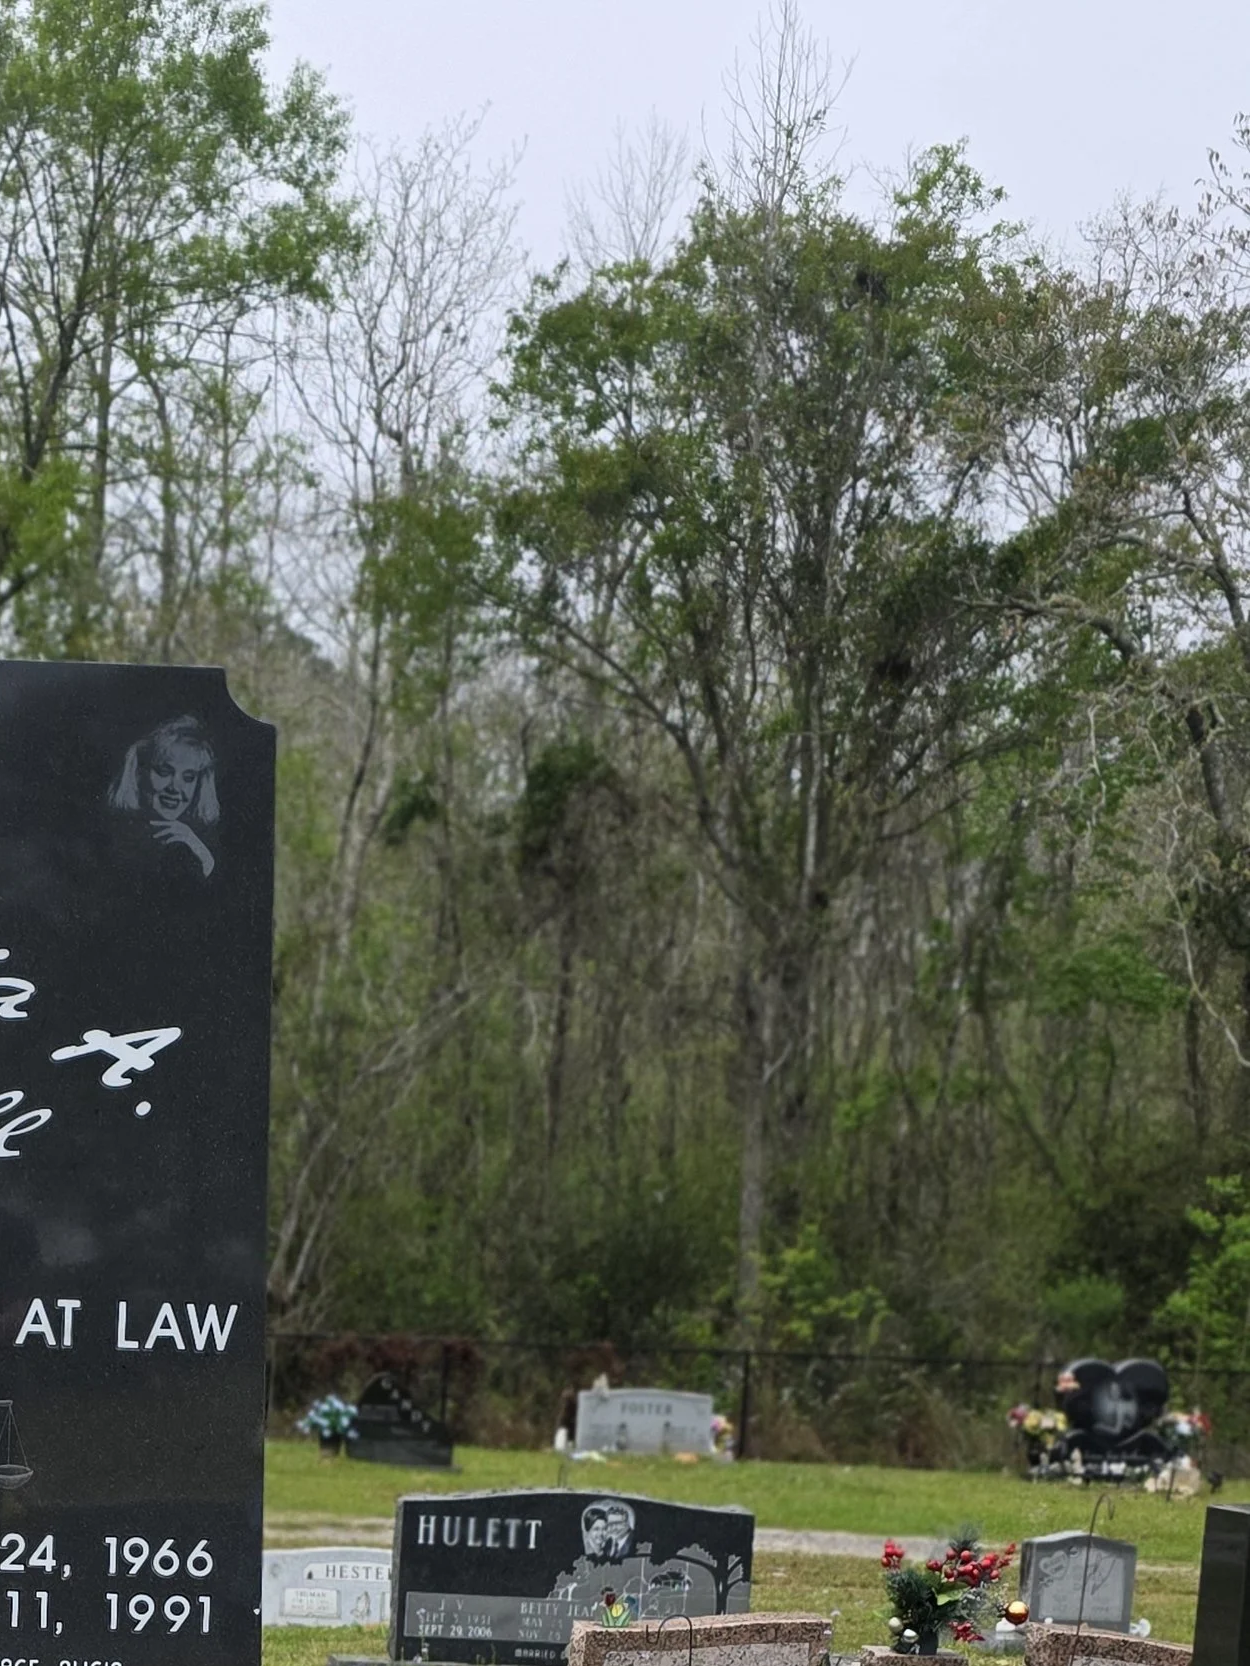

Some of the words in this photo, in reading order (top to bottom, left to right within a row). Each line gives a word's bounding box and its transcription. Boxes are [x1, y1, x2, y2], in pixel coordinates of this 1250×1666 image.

[52, 1028, 181, 1115] A.
[15, 1298, 81, 1347] AT
[117, 1301, 238, 1351] LAW
[418, 1515, 542, 1549] HULETT
[105, 1536, 214, 1577] 1966
[7, 1590, 63, 1635] 11,
[106, 1593, 211, 1633] 1991
[520, 1602, 560, 1616] BETTY
[418, 1624, 443, 1637] SEPT
[468, 1626, 493, 1639] 2006
